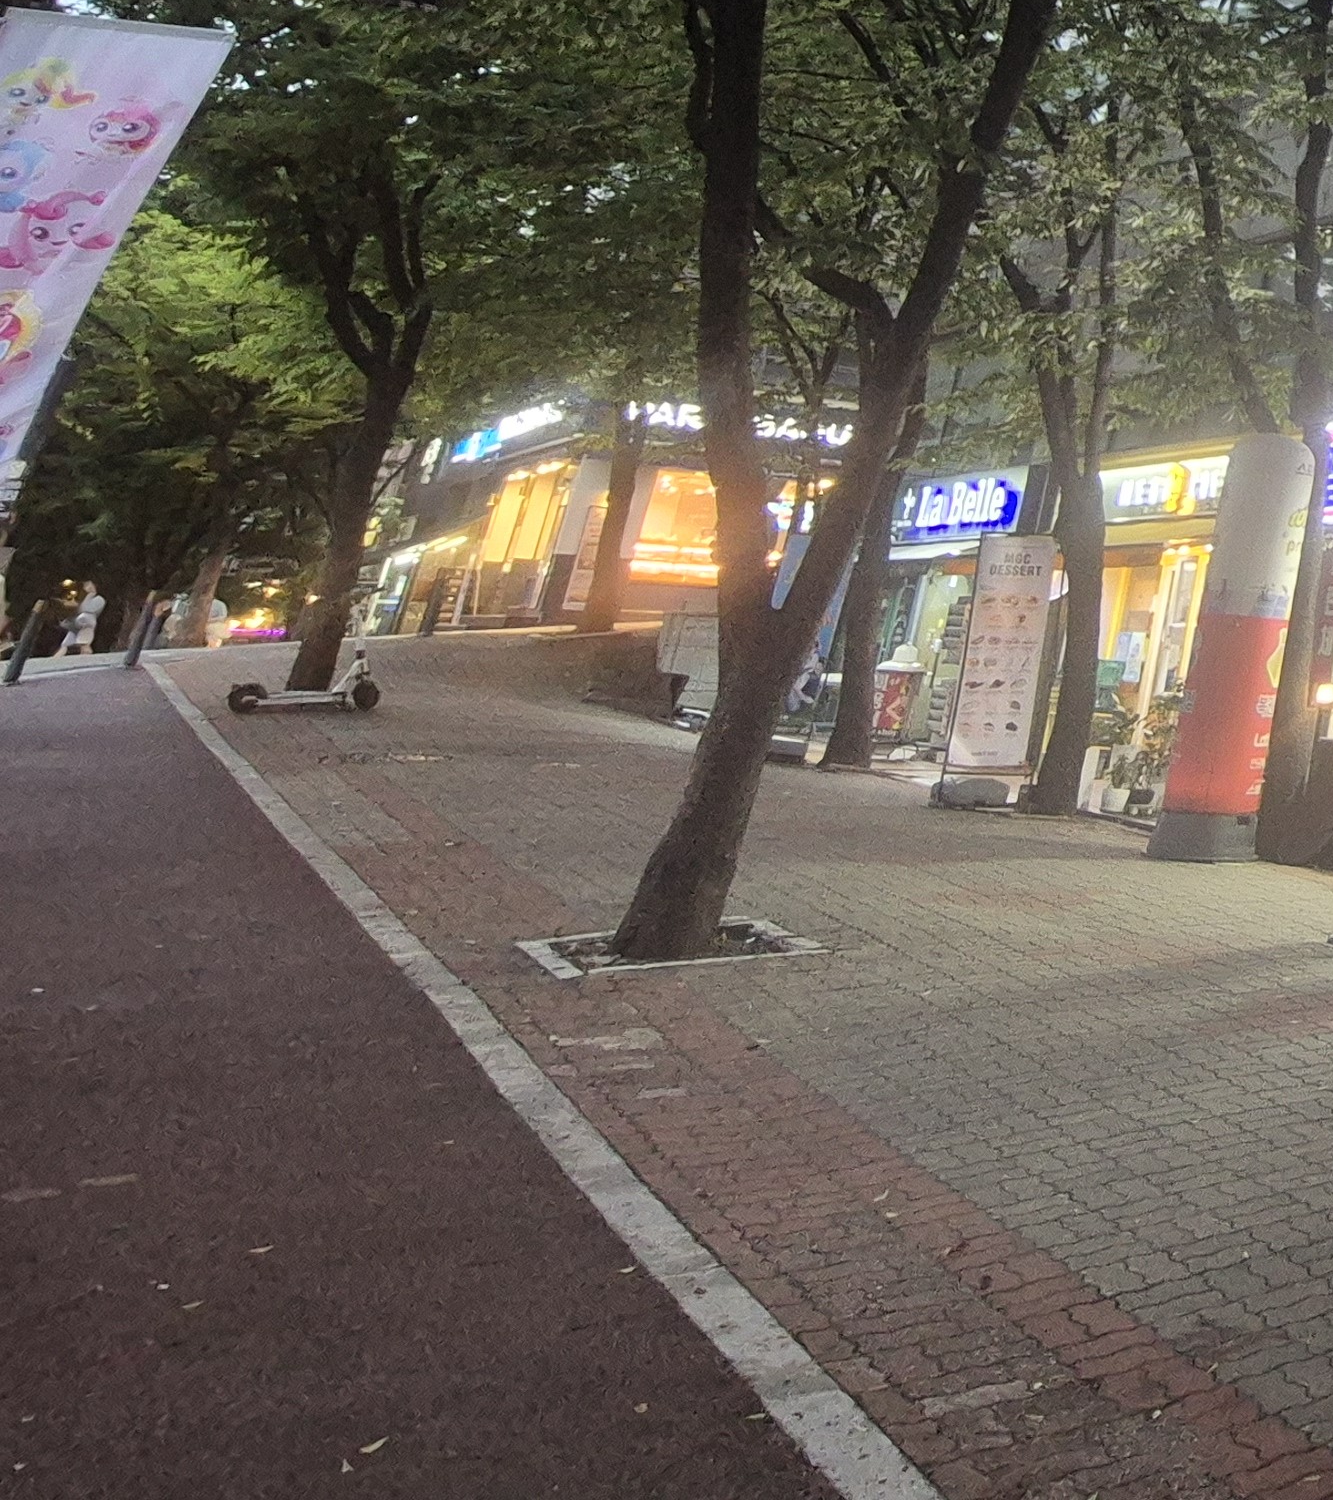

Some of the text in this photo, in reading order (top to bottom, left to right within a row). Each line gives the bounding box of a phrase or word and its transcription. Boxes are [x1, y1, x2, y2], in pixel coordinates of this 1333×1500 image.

[628, 400, 705, 430] PAR
[915, 486, 944, 527] La
[947, 477, 1006, 526] Belle
[989, 565, 1043, 577] DESSERT
